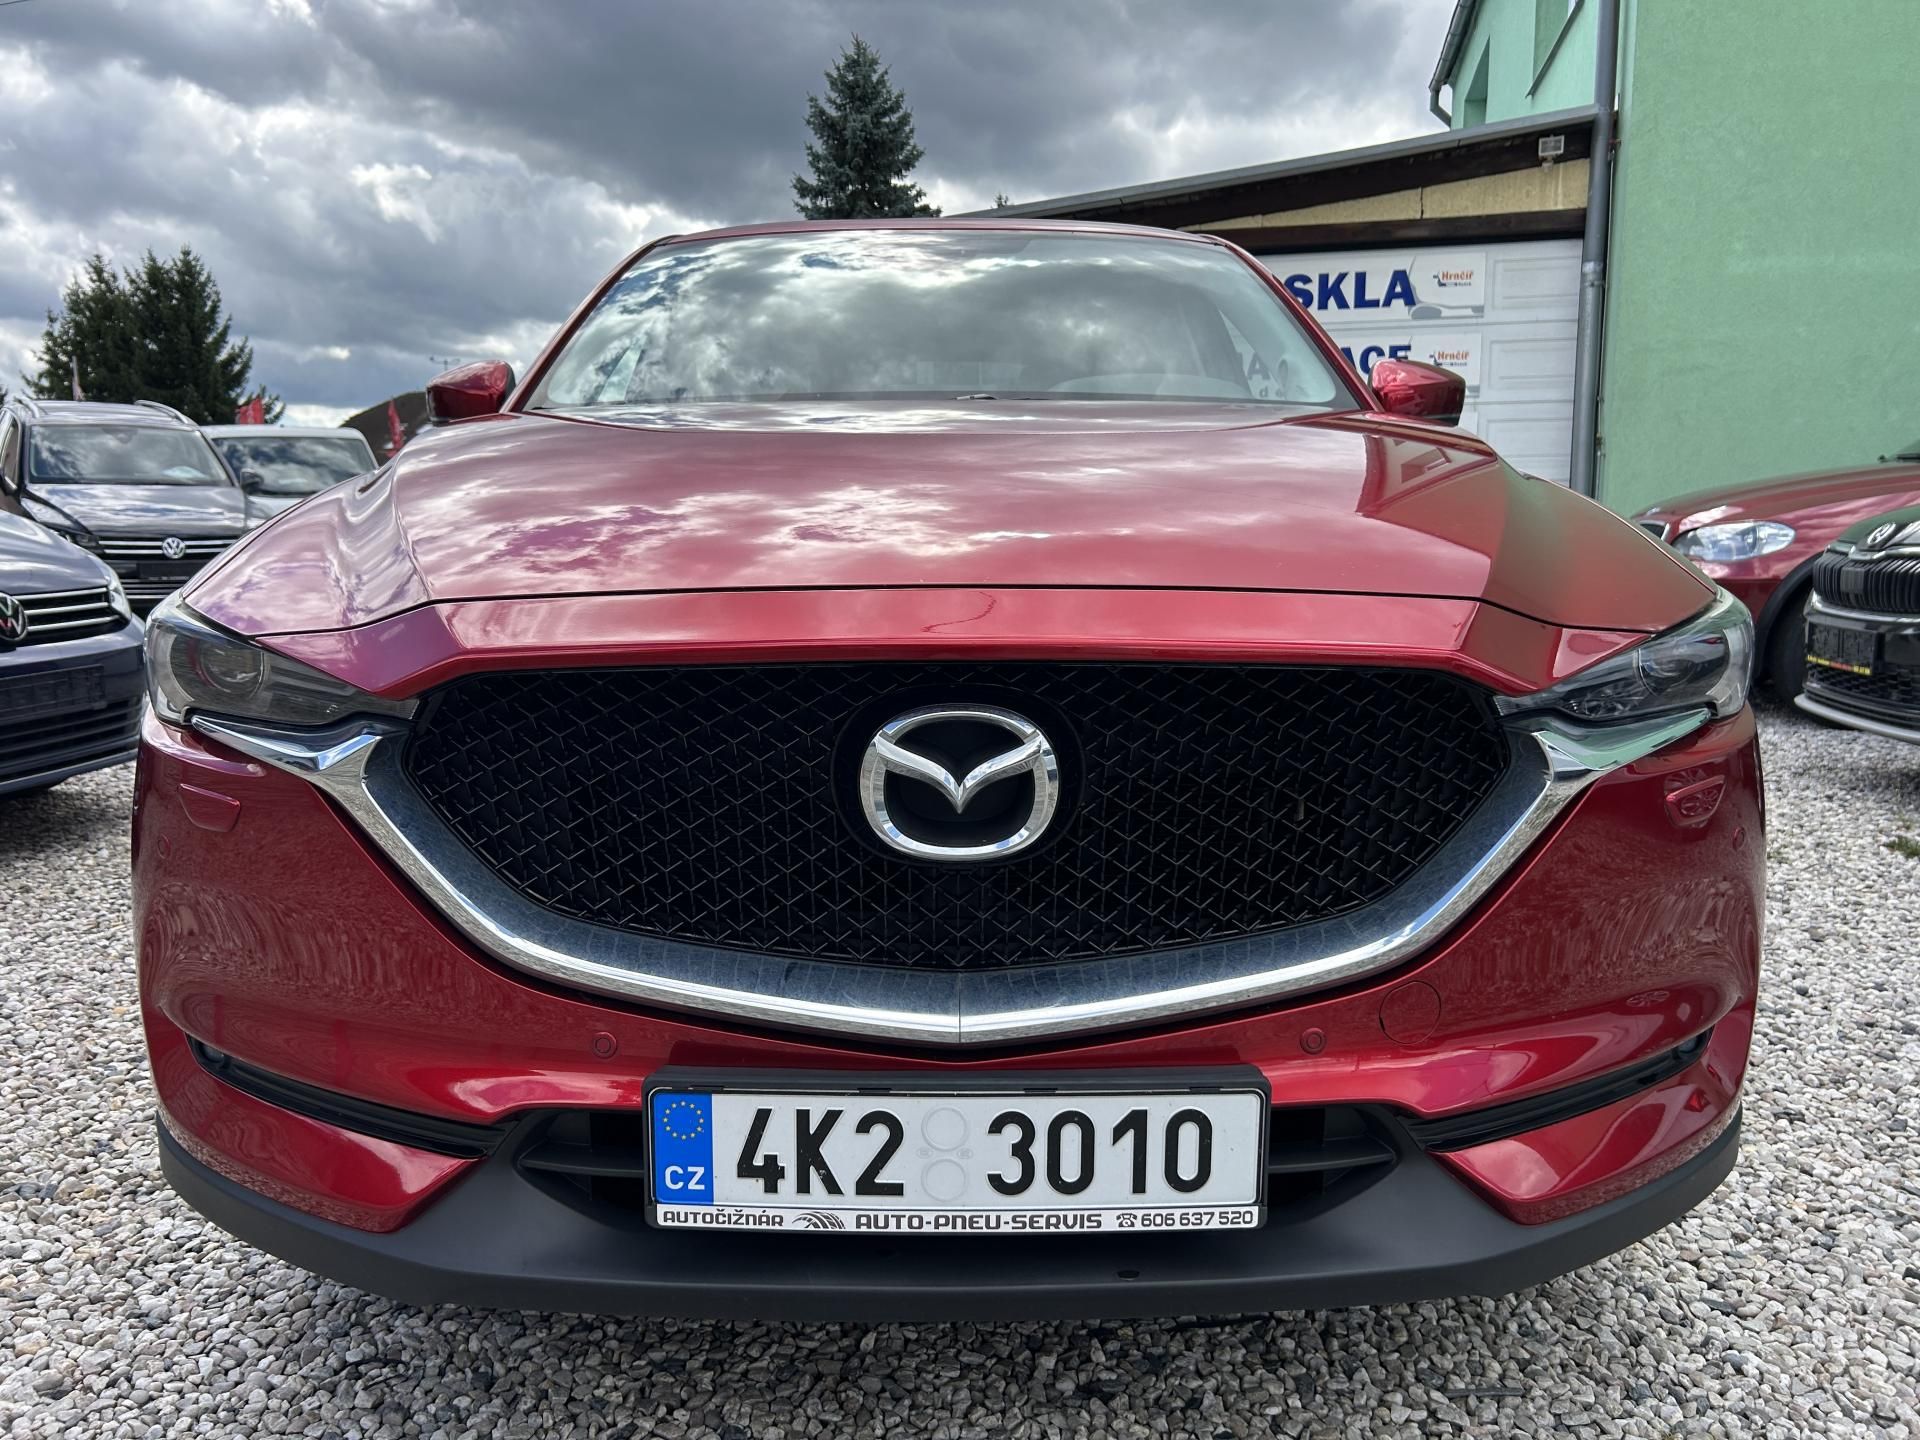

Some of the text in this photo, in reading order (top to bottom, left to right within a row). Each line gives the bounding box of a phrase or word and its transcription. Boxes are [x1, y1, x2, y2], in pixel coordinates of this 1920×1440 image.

[1283, 270, 1416, 311] SKLA
[737, 1109, 1212, 1196] 4K2 3010
[665, 1165, 705, 1190] CZ
[1141, 1212, 1175, 1227] 606
[1179, 1211, 1214, 1226] 637
[1218, 1210, 1254, 1225] 520
